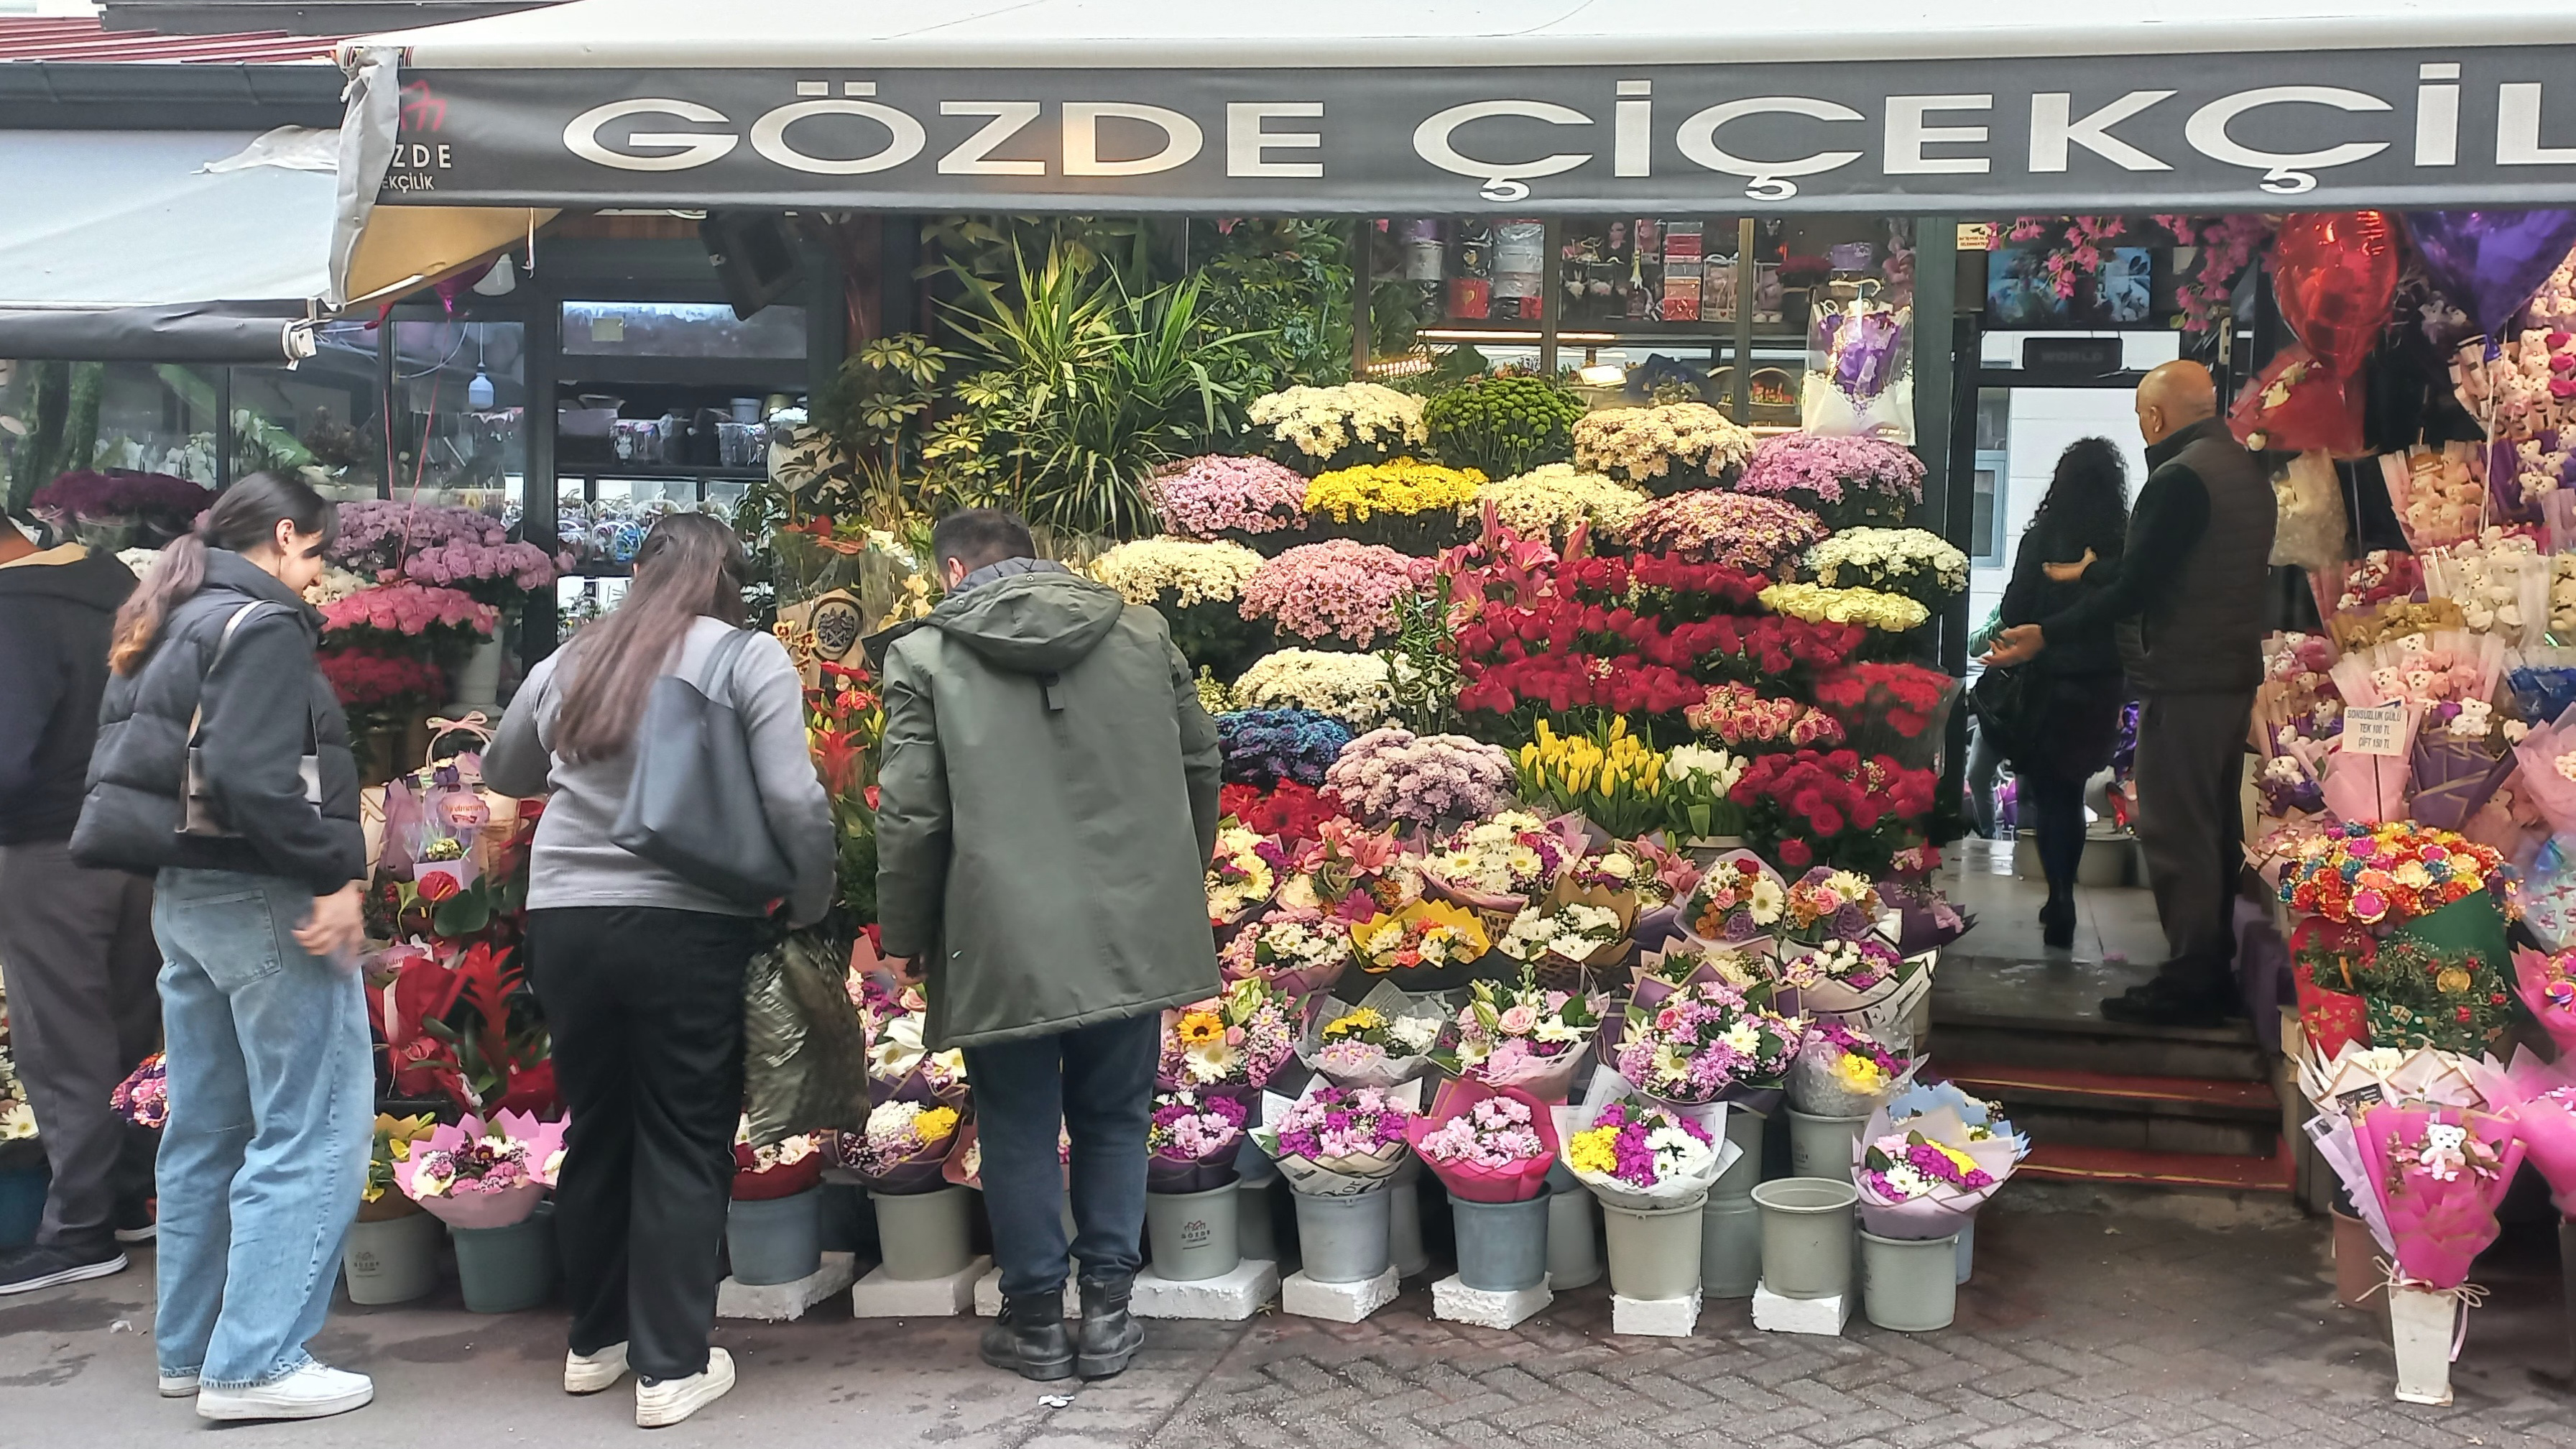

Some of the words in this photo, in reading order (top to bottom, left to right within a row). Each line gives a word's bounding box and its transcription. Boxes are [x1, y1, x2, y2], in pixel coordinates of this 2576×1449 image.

[563, 80, 1324, 178] GÖZDE
[1411, 62, 2576, 202] ÇİÇEKÇİL
[392, 144, 452, 168] ZDE
[382, 172, 435, 194] EKÇİLİK
[2347, 709, 2384, 720] SONSUZLUK
[2360, 723, 2372, 733] TEK
[2373, 724, 2383, 734] 100
[2383, 724, 2391, 735] TL
[2358, 735, 2372, 748] ÇİFT
[2383, 738, 2390, 749] TL
